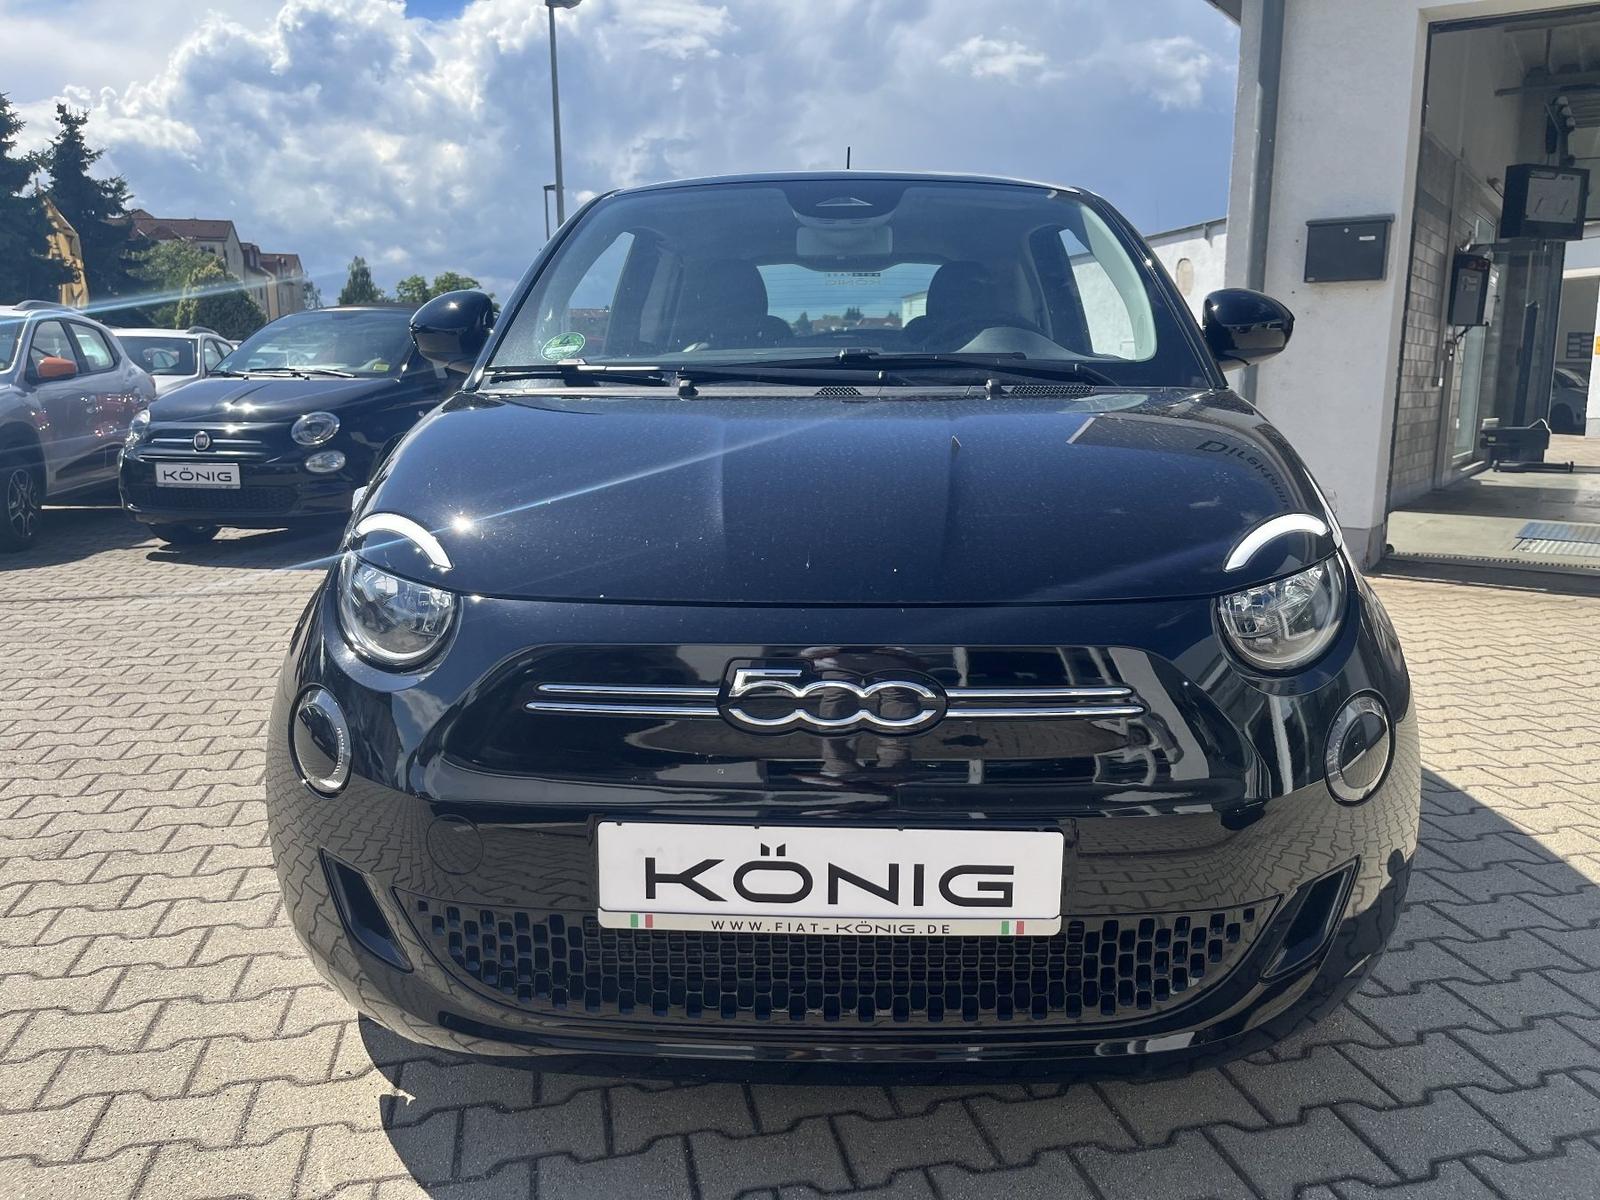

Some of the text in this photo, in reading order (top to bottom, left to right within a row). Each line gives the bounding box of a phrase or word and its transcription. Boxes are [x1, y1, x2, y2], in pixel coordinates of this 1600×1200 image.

[163, 467, 232, 482] KÖNIG
[728, 667, 937, 727] 500
[645, 843, 1015, 908] KÖNIG
[711, 919, 951, 935] WWW.FIAT-KÖNIG.DE
